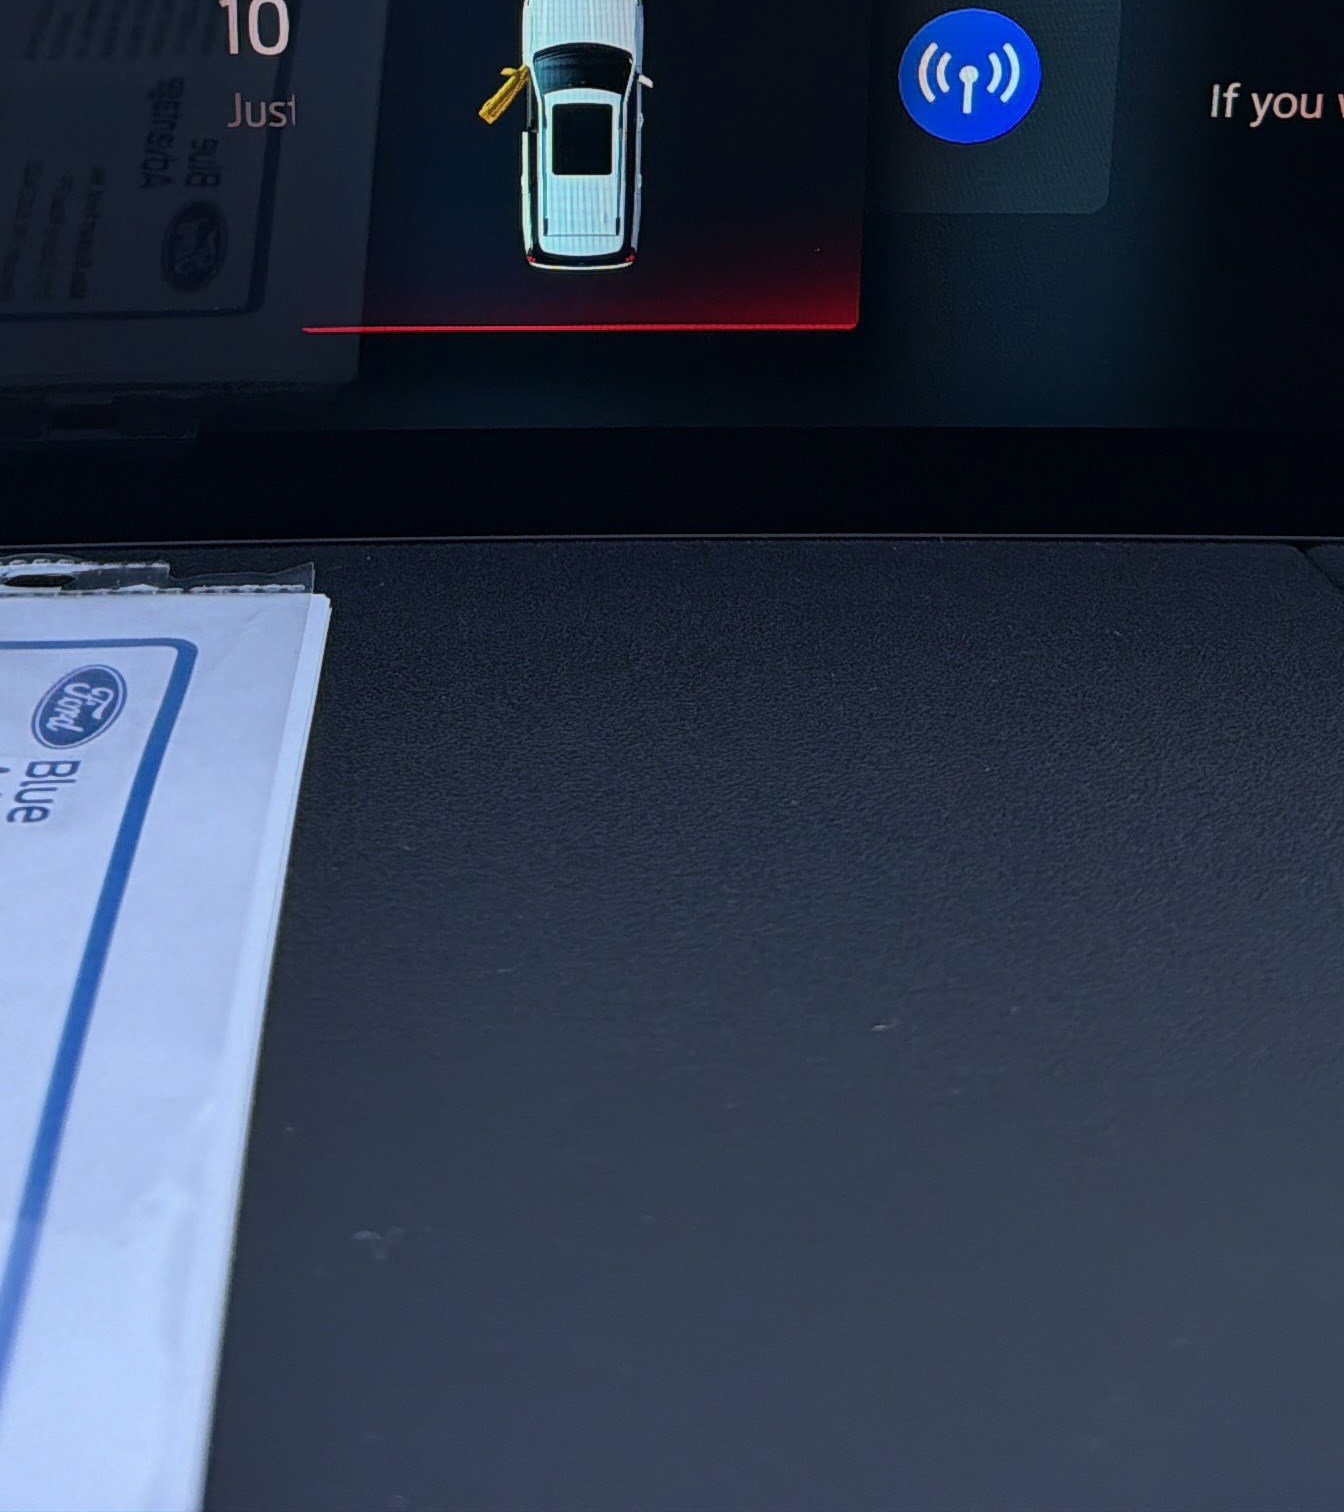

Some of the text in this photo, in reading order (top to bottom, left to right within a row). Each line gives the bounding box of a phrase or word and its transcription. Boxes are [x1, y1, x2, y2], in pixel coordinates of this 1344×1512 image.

[1211, 82, 1242, 119] If
[1249, 92, 1323, 129] you
[6, 760, 81, 824] Blue
